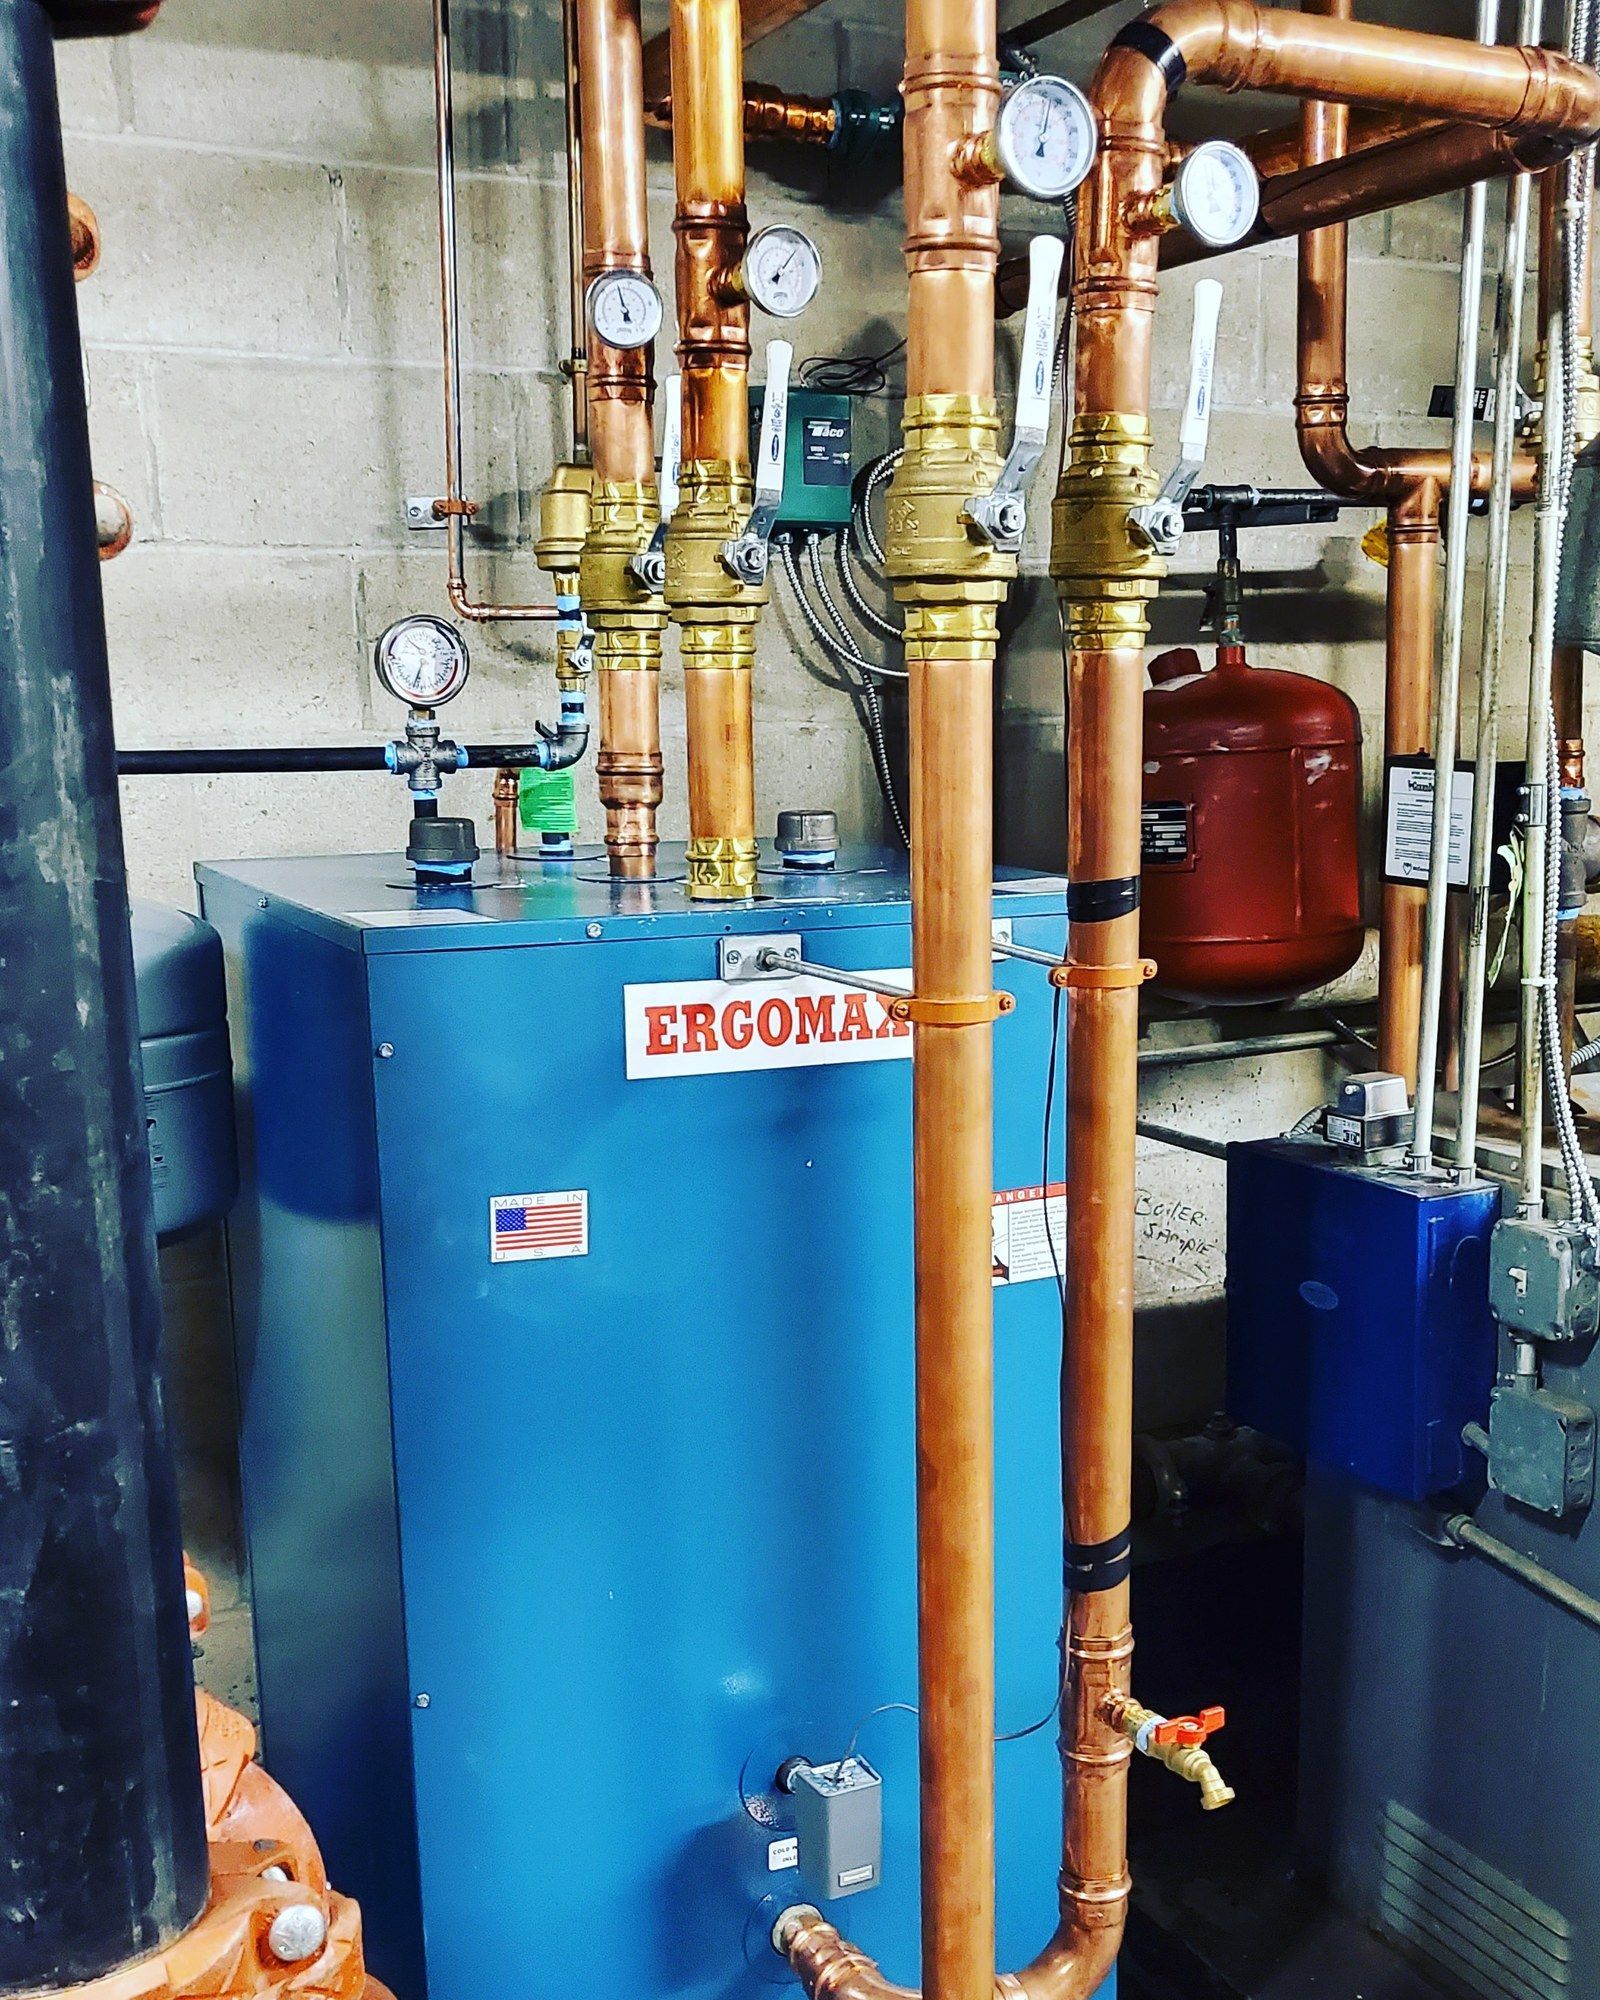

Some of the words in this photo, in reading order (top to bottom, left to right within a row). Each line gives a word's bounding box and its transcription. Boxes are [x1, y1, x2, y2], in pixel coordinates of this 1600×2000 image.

[1476, 389, 1487, 410] LEAD
[807, 420, 845, 438] Taco
[644, 993, 910, 1056] ERGOMAX
[494, 1196, 545, 1208] MADE
[566, 1193, 583, 1202] IN
[773, 1847, 790, 1856] COLD
